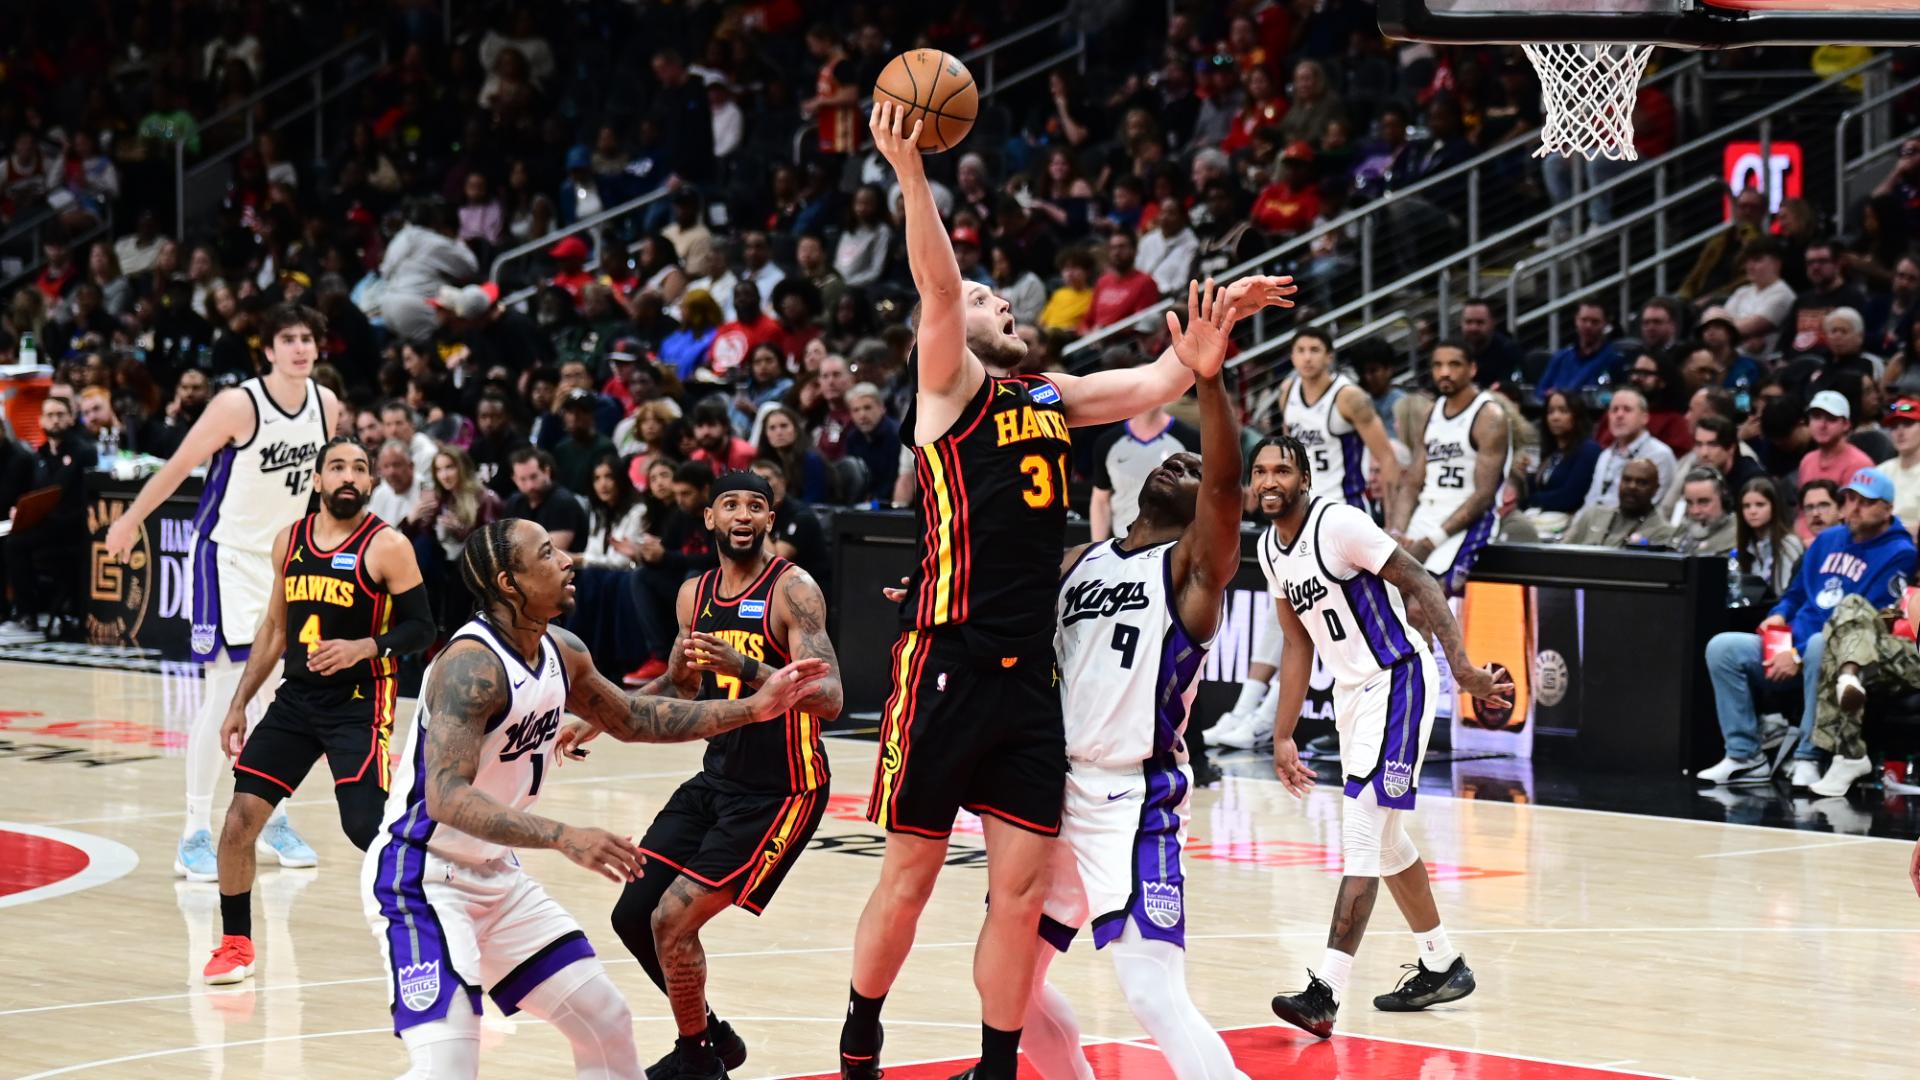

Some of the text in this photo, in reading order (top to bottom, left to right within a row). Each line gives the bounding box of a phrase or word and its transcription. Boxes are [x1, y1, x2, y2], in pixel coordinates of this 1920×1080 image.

[259, 440, 319, 474] Kings
[285, 468, 312, 496] 42
[1020, 455, 1070, 509] 31
[1438, 466, 1465, 489] 25
[285, 574, 355, 608] HAWKS
[1061, 579, 1149, 627] Kings
[298, 613, 321, 655] 4
[1322, 608, 1346, 642] 0
[1110, 623, 1140, 670] 9
[716, 673, 741, 702] 7
[499, 705, 561, 763] Kings
[528, 753, 544, 796] 1
[1147, 899, 1180, 912] KINGS
[402, 980, 438, 996] KINGS
